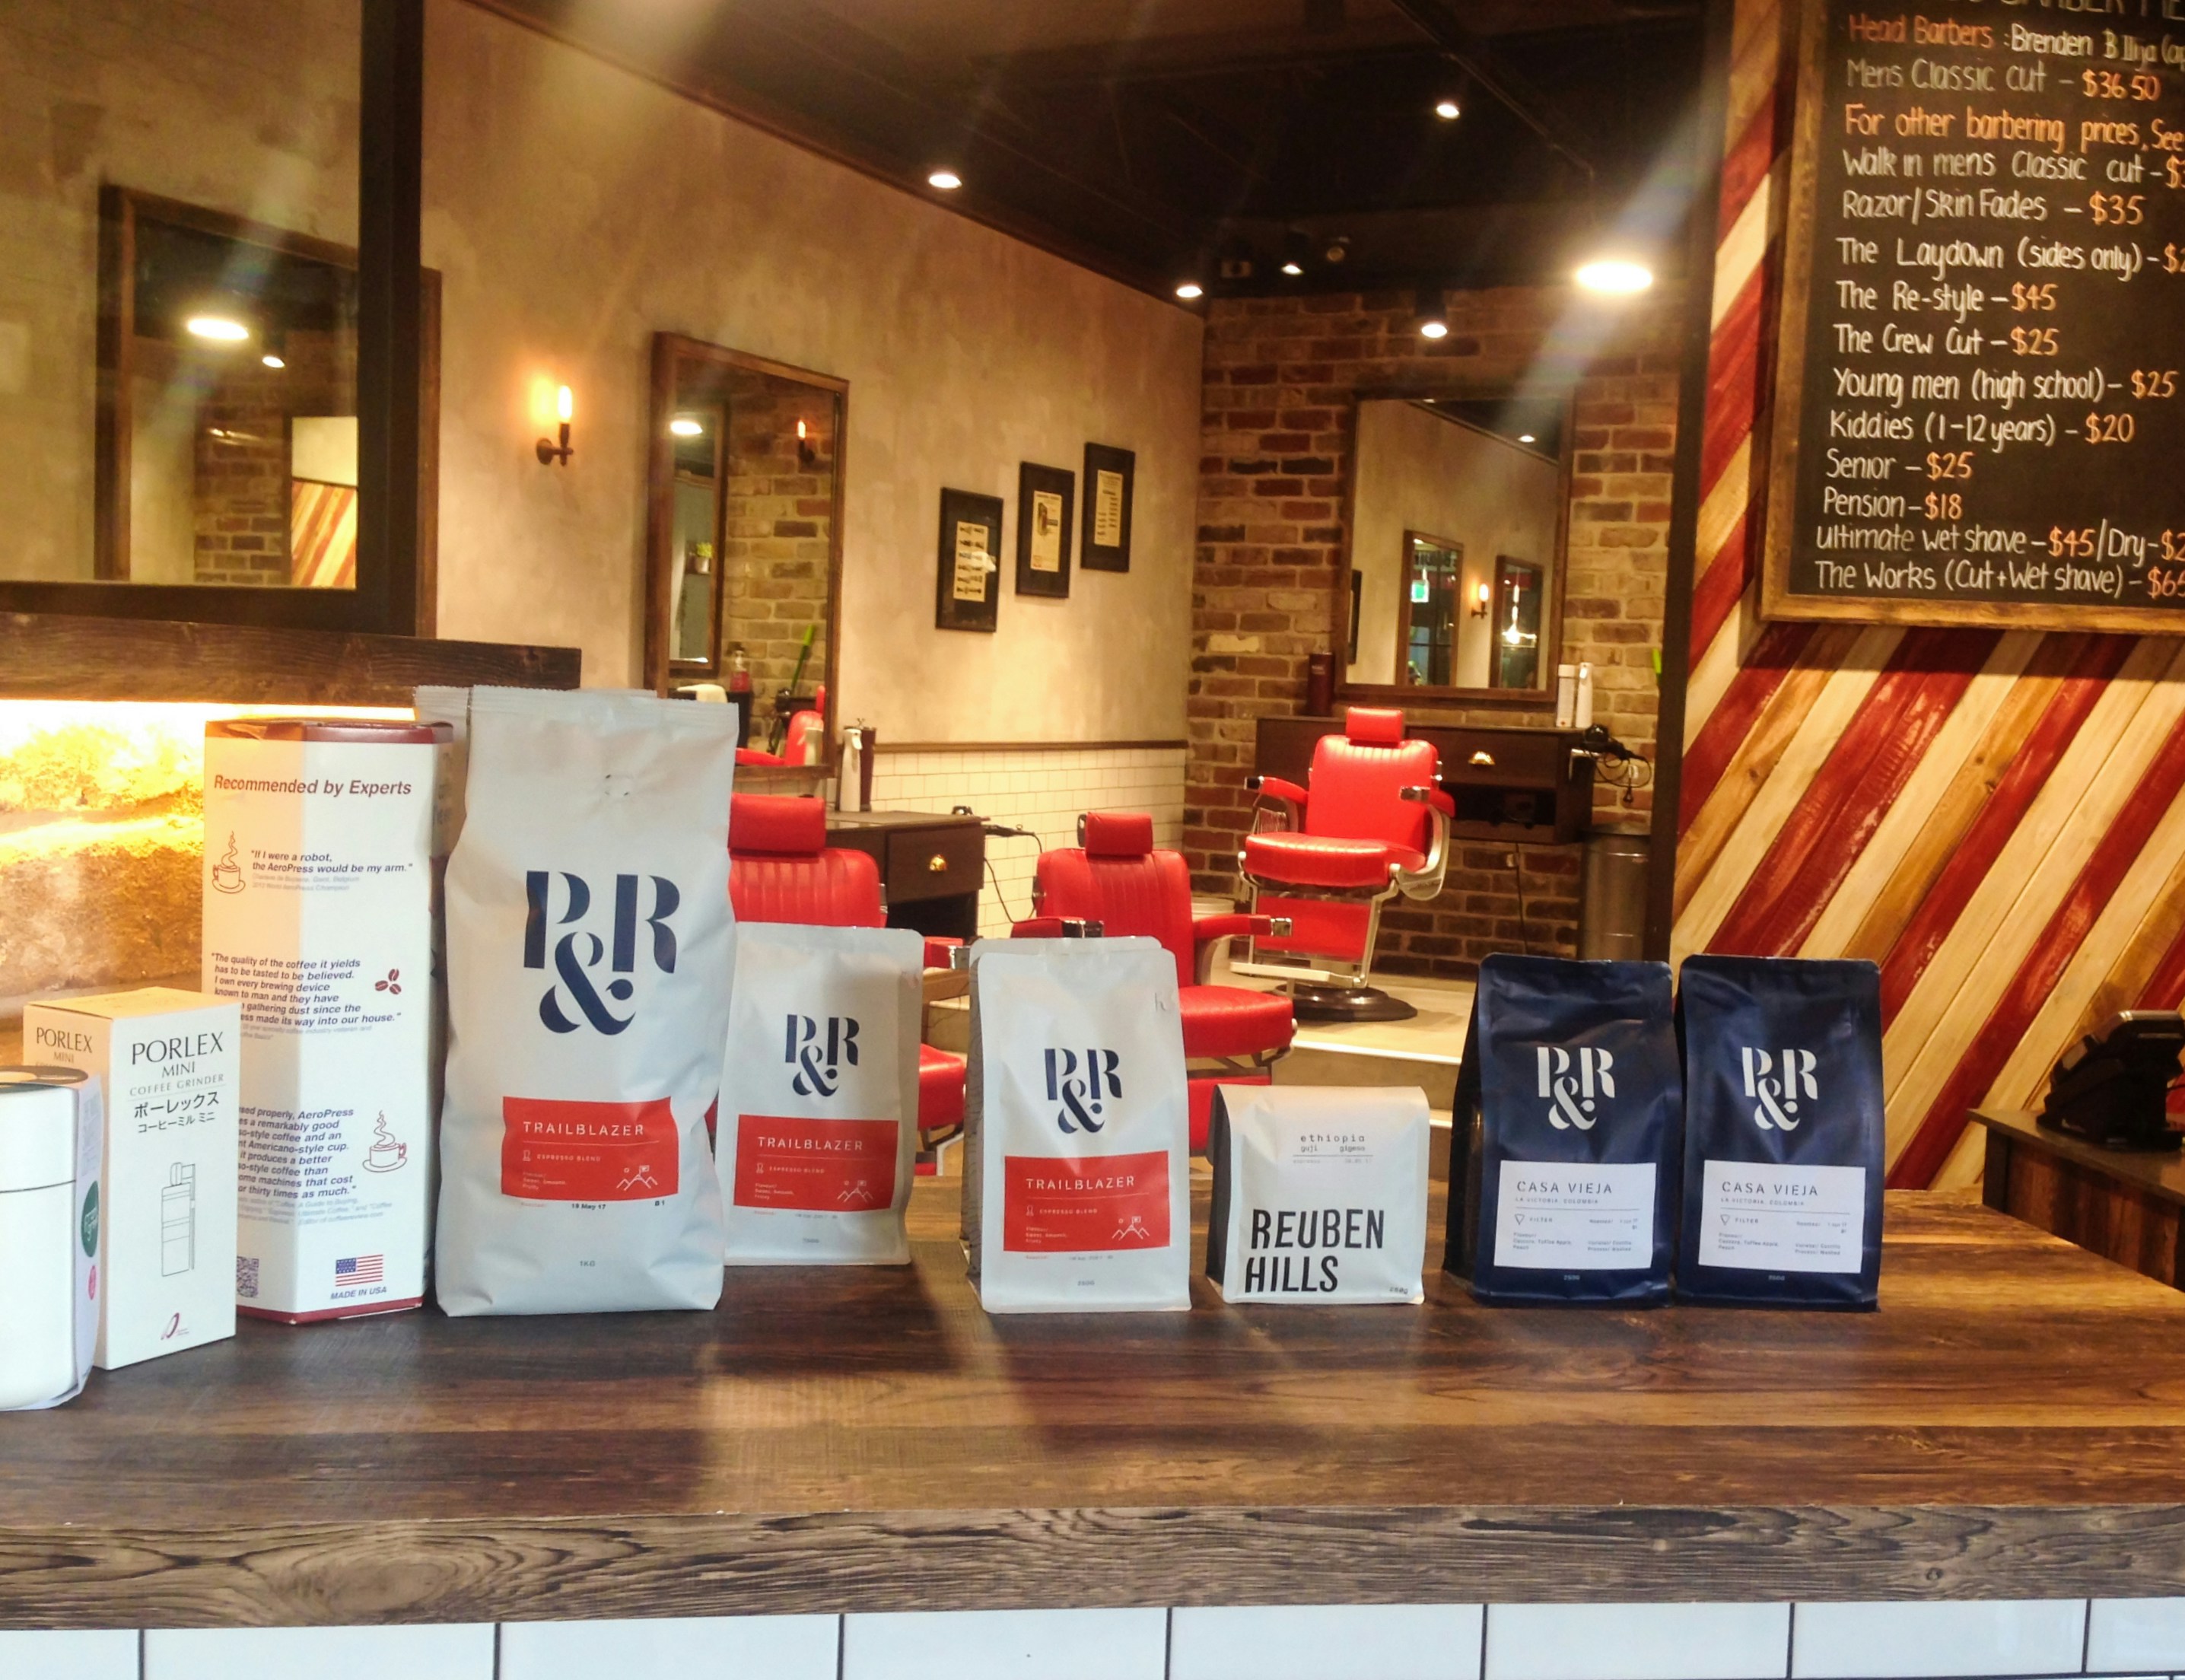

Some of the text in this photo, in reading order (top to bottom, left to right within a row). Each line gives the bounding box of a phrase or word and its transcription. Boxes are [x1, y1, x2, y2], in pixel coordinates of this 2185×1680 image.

[1849, 14, 1907, 43] Head
[1914, 17, 1993, 48] Barbers
[1846, 59, 2047, 92] Mens Classic cut
[1844, 103, 1884, 135] For
[1895, 107, 1955, 138] other
[1966, 105, 2066, 154] barbering
[1843, 147, 1897, 177] Walk
[1902, 151, 1923, 177] in
[1933, 151, 1996, 177] mens
[2012, 148, 2088, 180] Classic
[1979, 189, 2047, 221] Fades
[1836, 237, 1878, 265] The
[1896, 238, 2004, 282] Laydown
[2017, 236, 2084, 269] (sides
[1835, 280, 1878, 310] The
[1892, 281, 1984, 323] Re-style
[1834, 323, 1872, 354] The
[1882, 323, 1933, 355] Crew
[1945, 326, 1984, 355] Cut
[1834, 368, 1902, 409] Young
[1912, 372, 1959, 400] men
[1972, 368, 2025, 410] (high
[2034, 368, 2104, 403] school)
[1830, 410, 1913, 441] Kiddies
[1991, 415, 2055, 453] years)
[1826, 448, 1897, 479] Senior
[1824, 486, 1905, 518] Pension
[1922, 525, 1958, 551] wet
[1964, 525, 2027, 555] shave
[1815, 560, 1856, 590] The
[1864, 563, 1935, 590] Works
[2054, 563, 2124, 599] shave)
[214, 774, 412, 798] Recommended by Experts
[269, 853, 332, 862] were robot,
[253, 862, 382, 874] the AeroPress would be my
[231, 956, 361, 970] quality the coffee yields
[253, 969, 355, 980] tasted believed.
[237, 978, 259, 990] every
[261, 981, 294, 993] brewing
[296, 983, 330, 991] device
[215, 987, 239, 998] known
[272, 993, 287, 1002] and
[290, 994, 310, 1005] they
[313, 994, 339, 1003] have
[247, 1003, 286, 1015] gathering
[289, 1006, 310, 1014] dust
[313, 1005, 341, 1014] since
[345, 1004, 361, 1013] the
[256, 1015, 279, 1024] made
[295, 1019, 315, 1027] way
[317, 1017, 338, 1025] into
[37, 1026, 92, 1053] PORLEX
[132, 1031, 223, 1065] PORLEX
[54, 1052, 74, 1063] MINI
[162, 1061, 195, 1078] MINI
[129, 1074, 224, 1096] COFFEE GRINDER
[135, 1091, 219, 1118] ポーレックス
[257, 1109, 295, 1120] properly,
[298, 1109, 354, 1119] AeroPress
[138, 1115, 196, 1133] コーヒーミル
[258, 1121, 310, 1132] remarkably
[312, 1120, 339, 1131] good
[523, 1122, 644, 1136] TRAILBLAZER
[272, 1132, 301, 1142] coffee
[304, 1132, 326, 1142] and
[328, 1132, 342, 1141] an
[758, 1137, 863, 1150] TRAILBLAZER
[1300, 1134, 1365, 1144] ethiopia
[249, 1140, 349, 1155] Americano-style cup.
[1300, 1144, 1318, 1153] guji
[248, 1153, 332, 1165] produces better
[272, 1166, 301, 1176] coffee
[304, 1167, 328, 1176] than
[259, 1176, 302, 1188] machines
[306, 1179, 327, 1187] that
[331, 1175, 353, 1185] cost
[1026, 1176, 1135, 1191] TRAILBLAZER
[1516, 1181, 1612, 1194] CASA VIEJA
[1722, 1181, 1818, 1196] CASA VIEJA
[249, 1185, 271, 1198] thirty
[273, 1188, 298, 1198] times
[1251, 1208, 1385, 1249] REUBEN
[1245, 1255, 1338, 1293] HILLS
[330, 1286, 387, 1300] MADE IN USA
